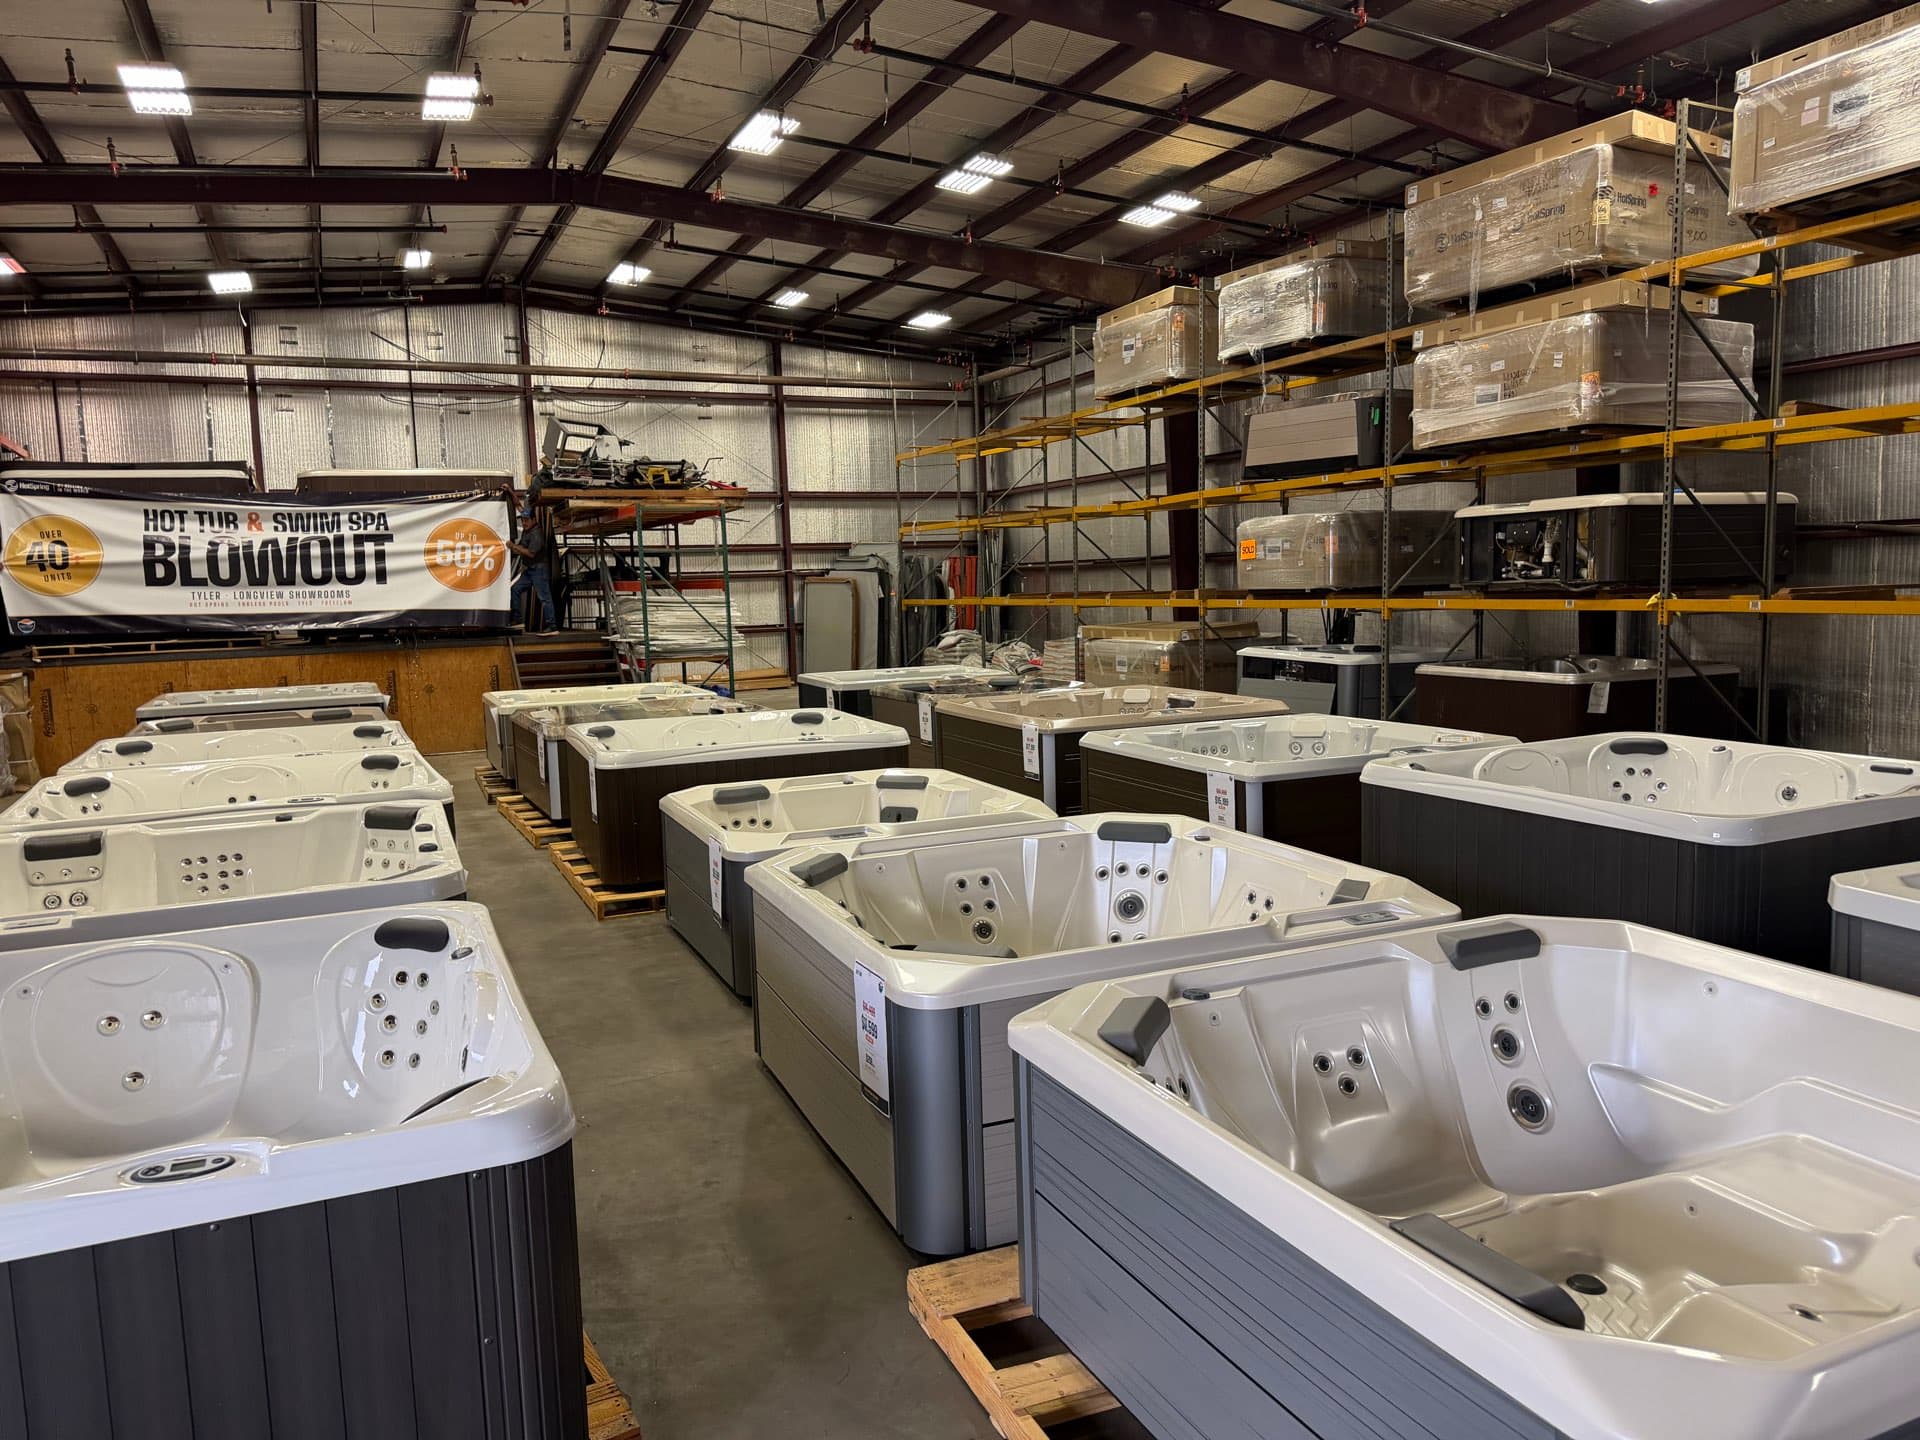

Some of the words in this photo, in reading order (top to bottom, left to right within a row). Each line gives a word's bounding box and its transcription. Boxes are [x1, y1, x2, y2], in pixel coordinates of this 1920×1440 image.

[1617, 192, 1647, 209] HotSpring
[143, 508, 188, 533] HOT
[194, 511, 239, 533] TUB
[247, 511, 265, 533] &
[272, 511, 341, 534] SWIM
[348, 511, 389, 532] SPA
[40, 529, 62, 539] OVER
[436, 539, 495, 571] 50%
[1242, 545, 1255, 554] SOLD
[142, 533, 394, 587] BLOWOUT
[43, 572, 72, 582] UNITS
[456, 569, 470, 577] OFF
[191, 591, 221, 600] TYLER
[233, 590, 284, 600] LONGVIEW
[289, 589, 351, 599] SHOWROOMS
